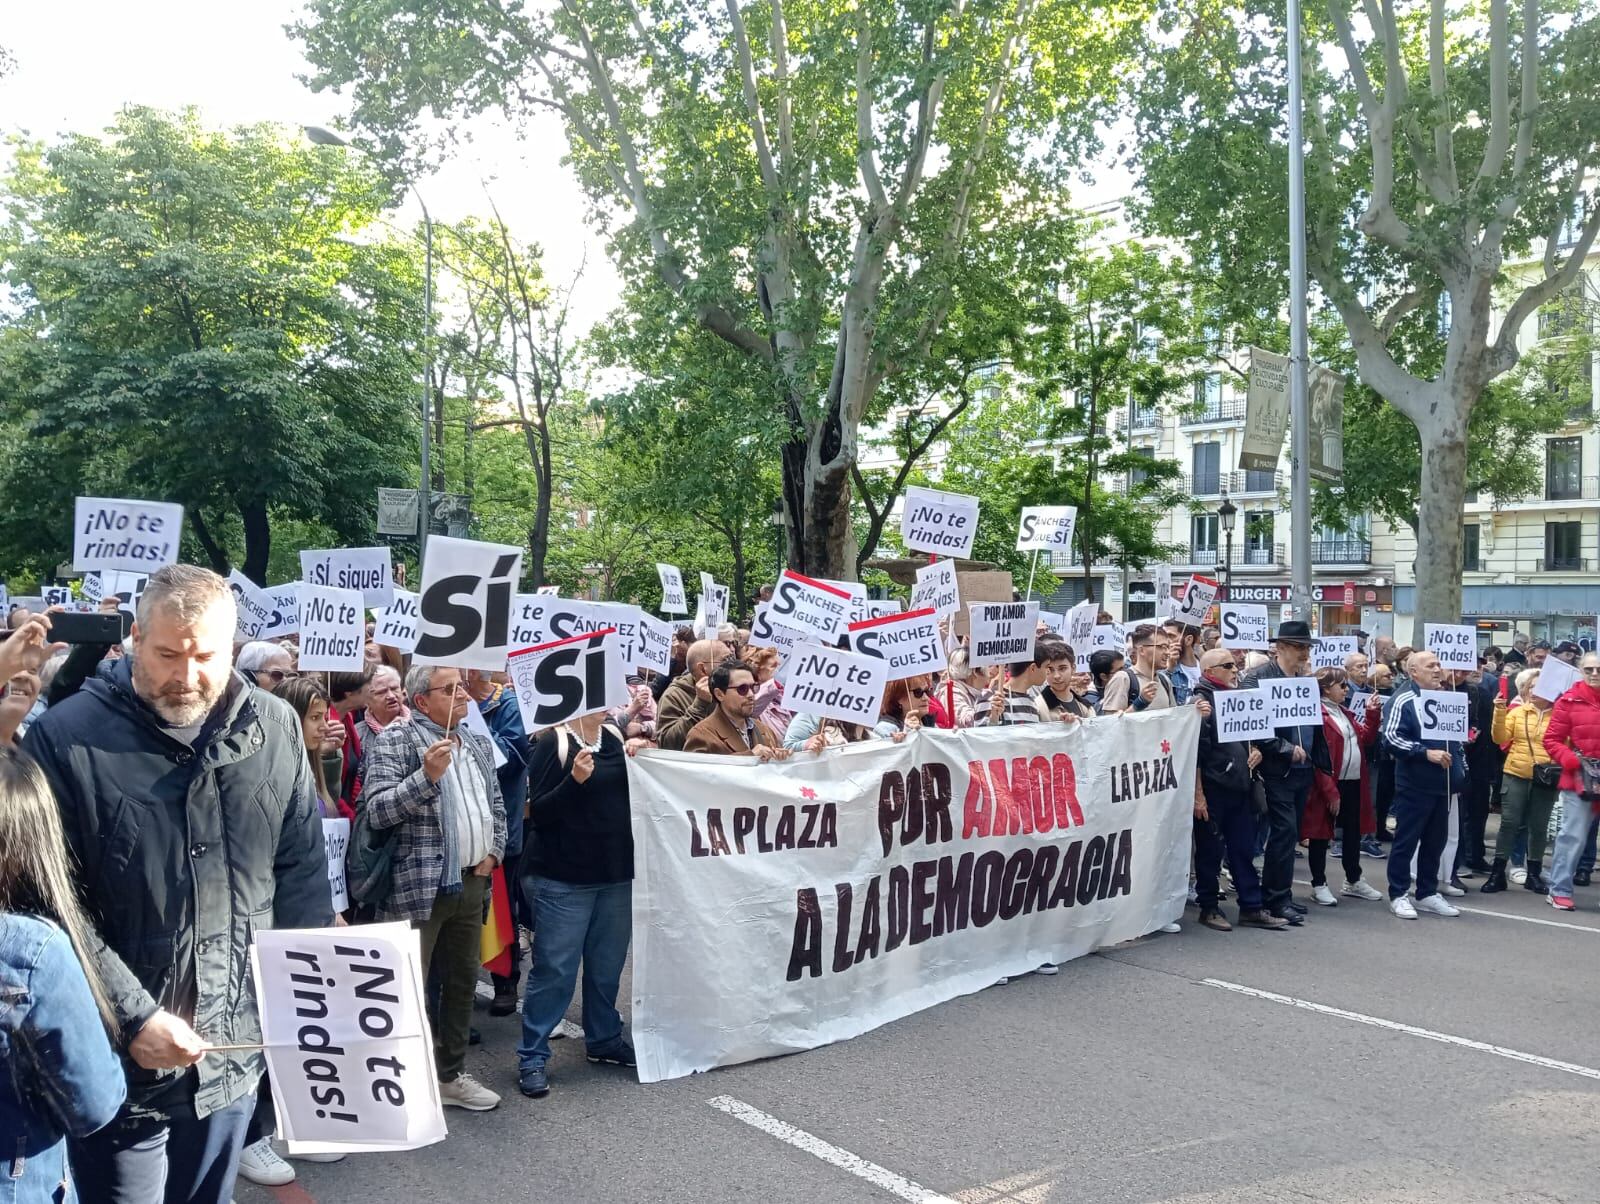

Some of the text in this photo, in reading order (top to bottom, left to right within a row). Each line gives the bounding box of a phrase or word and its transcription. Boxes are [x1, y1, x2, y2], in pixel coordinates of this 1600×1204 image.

[84, 509, 164, 535] ¡No te
[911, 506, 966, 528] ¡No te
[84, 538, 170, 562] rindas!
[909, 527, 968, 549] rindas!
[304, 597, 356, 627] ¡No te
[414, 554, 519, 658] SÍ
[522, 604, 544, 620] te
[984, 605, 1026, 621] POR AMOR
[995, 622, 1012, 638] A LA
[1429, 630, 1470, 646] ¡No te
[304, 630, 360, 658] rindas!
[976, 638, 1028, 657] DEMOCRACIA
[1314, 642, 1351, 655] ¡No te
[795, 654, 872, 686] ¡No te
[792, 682, 875, 715] rindas!
[1295, 685, 1310, 698] te
[1221, 697, 1264, 716] ¡No te
[1272, 703, 1317, 719] indas!
[1223, 715, 1269, 733] rindas!
[1111, 754, 1178, 803] LA PLAZA
[878, 753, 1085, 858] POR AMOR
[686, 803, 838, 857] LA PLAZA
[786, 829, 1133, 982] A LA DEMOCRACIA
[285, 949, 359, 1124] rindas!
[334, 944, 407, 1107] ¡No te
